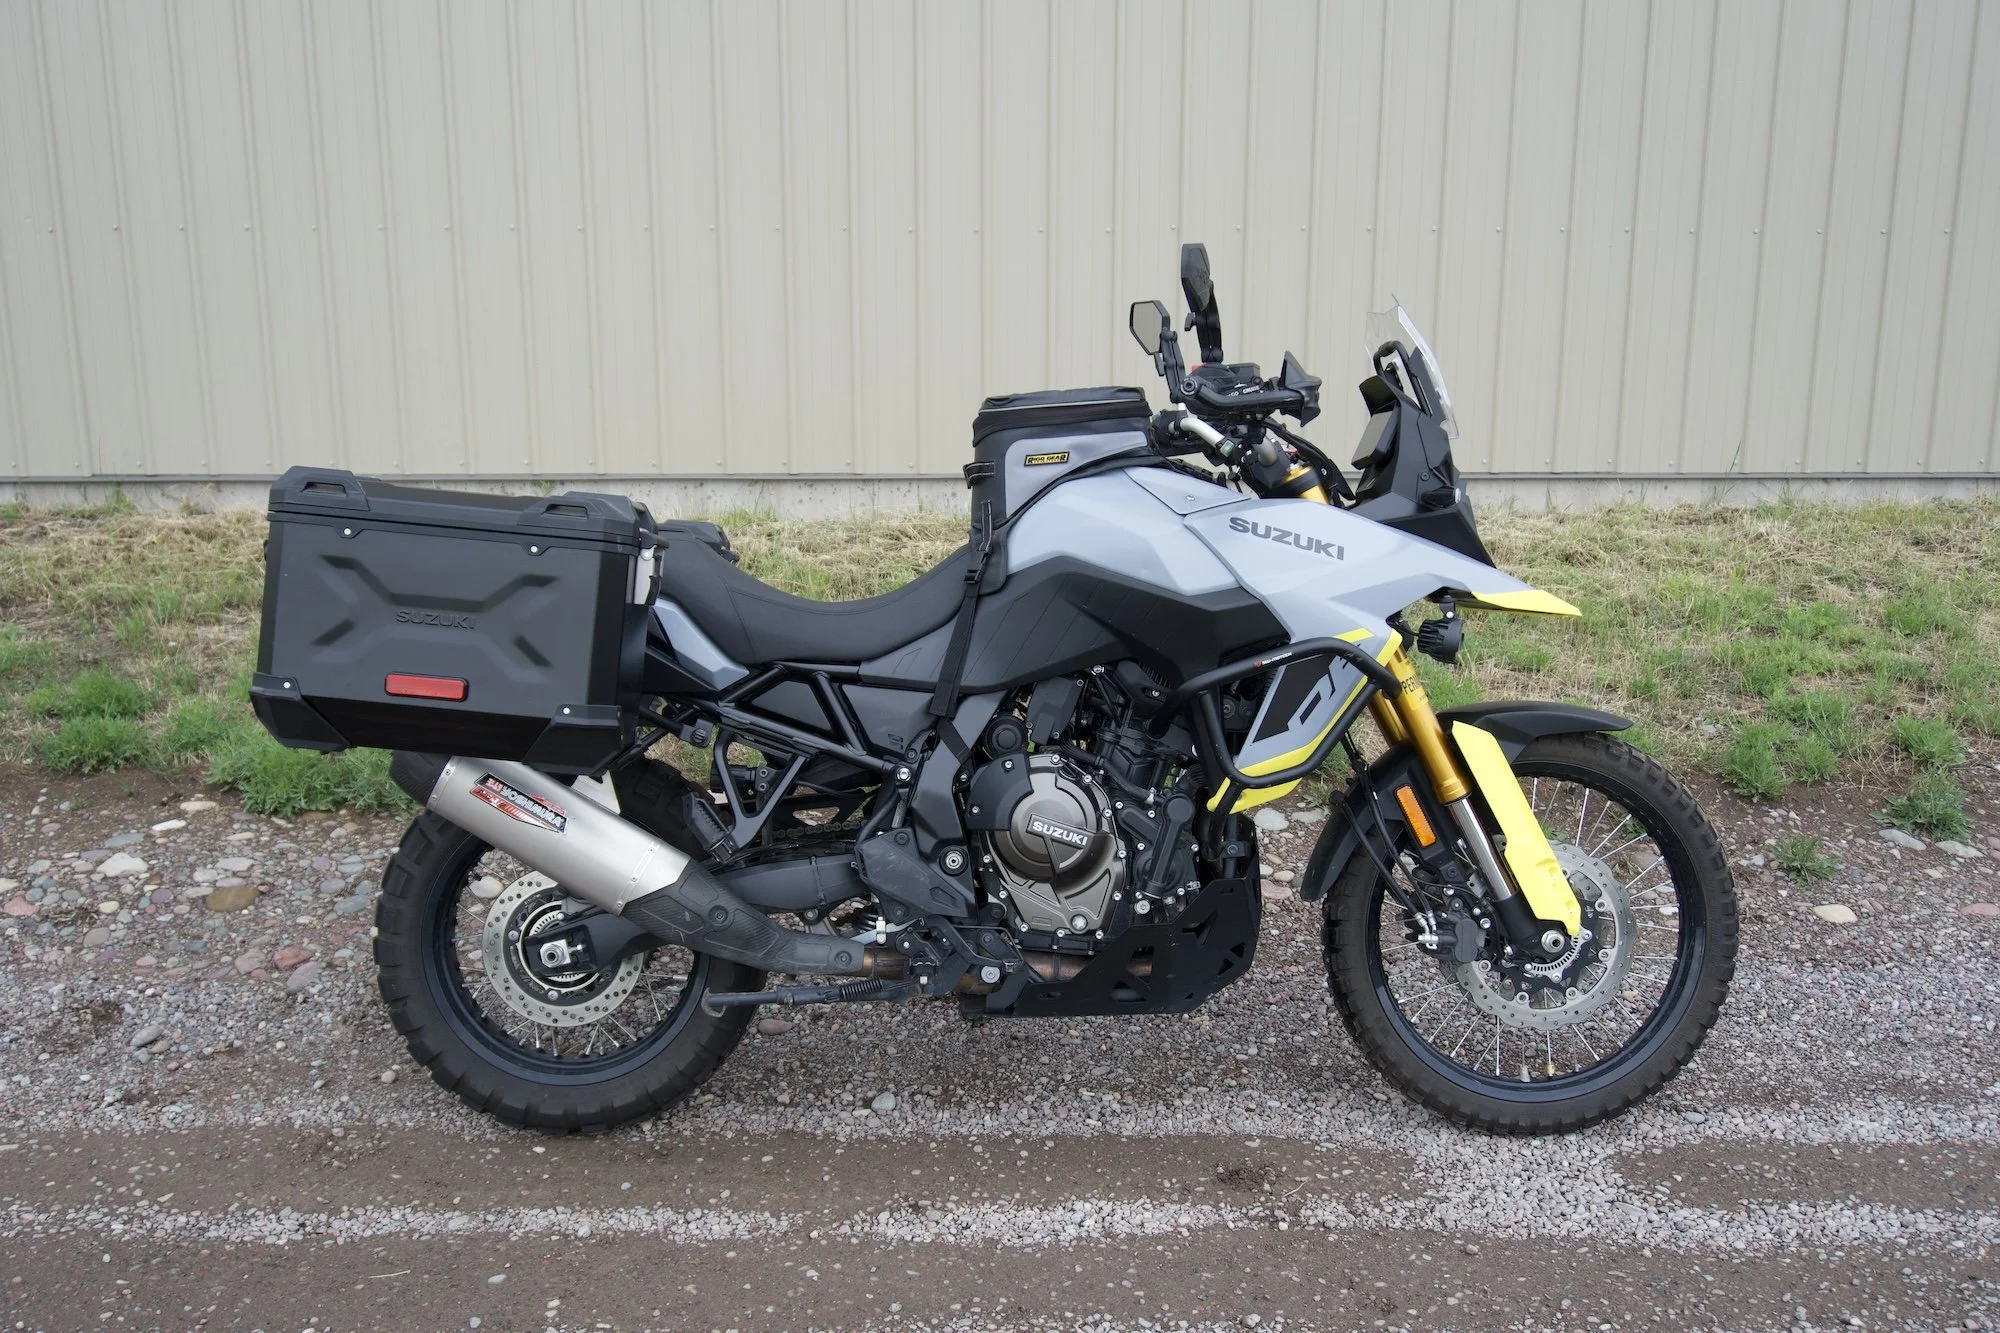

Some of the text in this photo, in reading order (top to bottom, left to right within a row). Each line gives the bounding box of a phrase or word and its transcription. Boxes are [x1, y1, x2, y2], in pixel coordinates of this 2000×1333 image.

[1229, 517, 1344, 560] SUZUKI
[396, 610, 476, 630] SUZUKI
[500, 785, 562, 828] YOSHIMURA
[1032, 821, 1088, 846] SUZUKI
